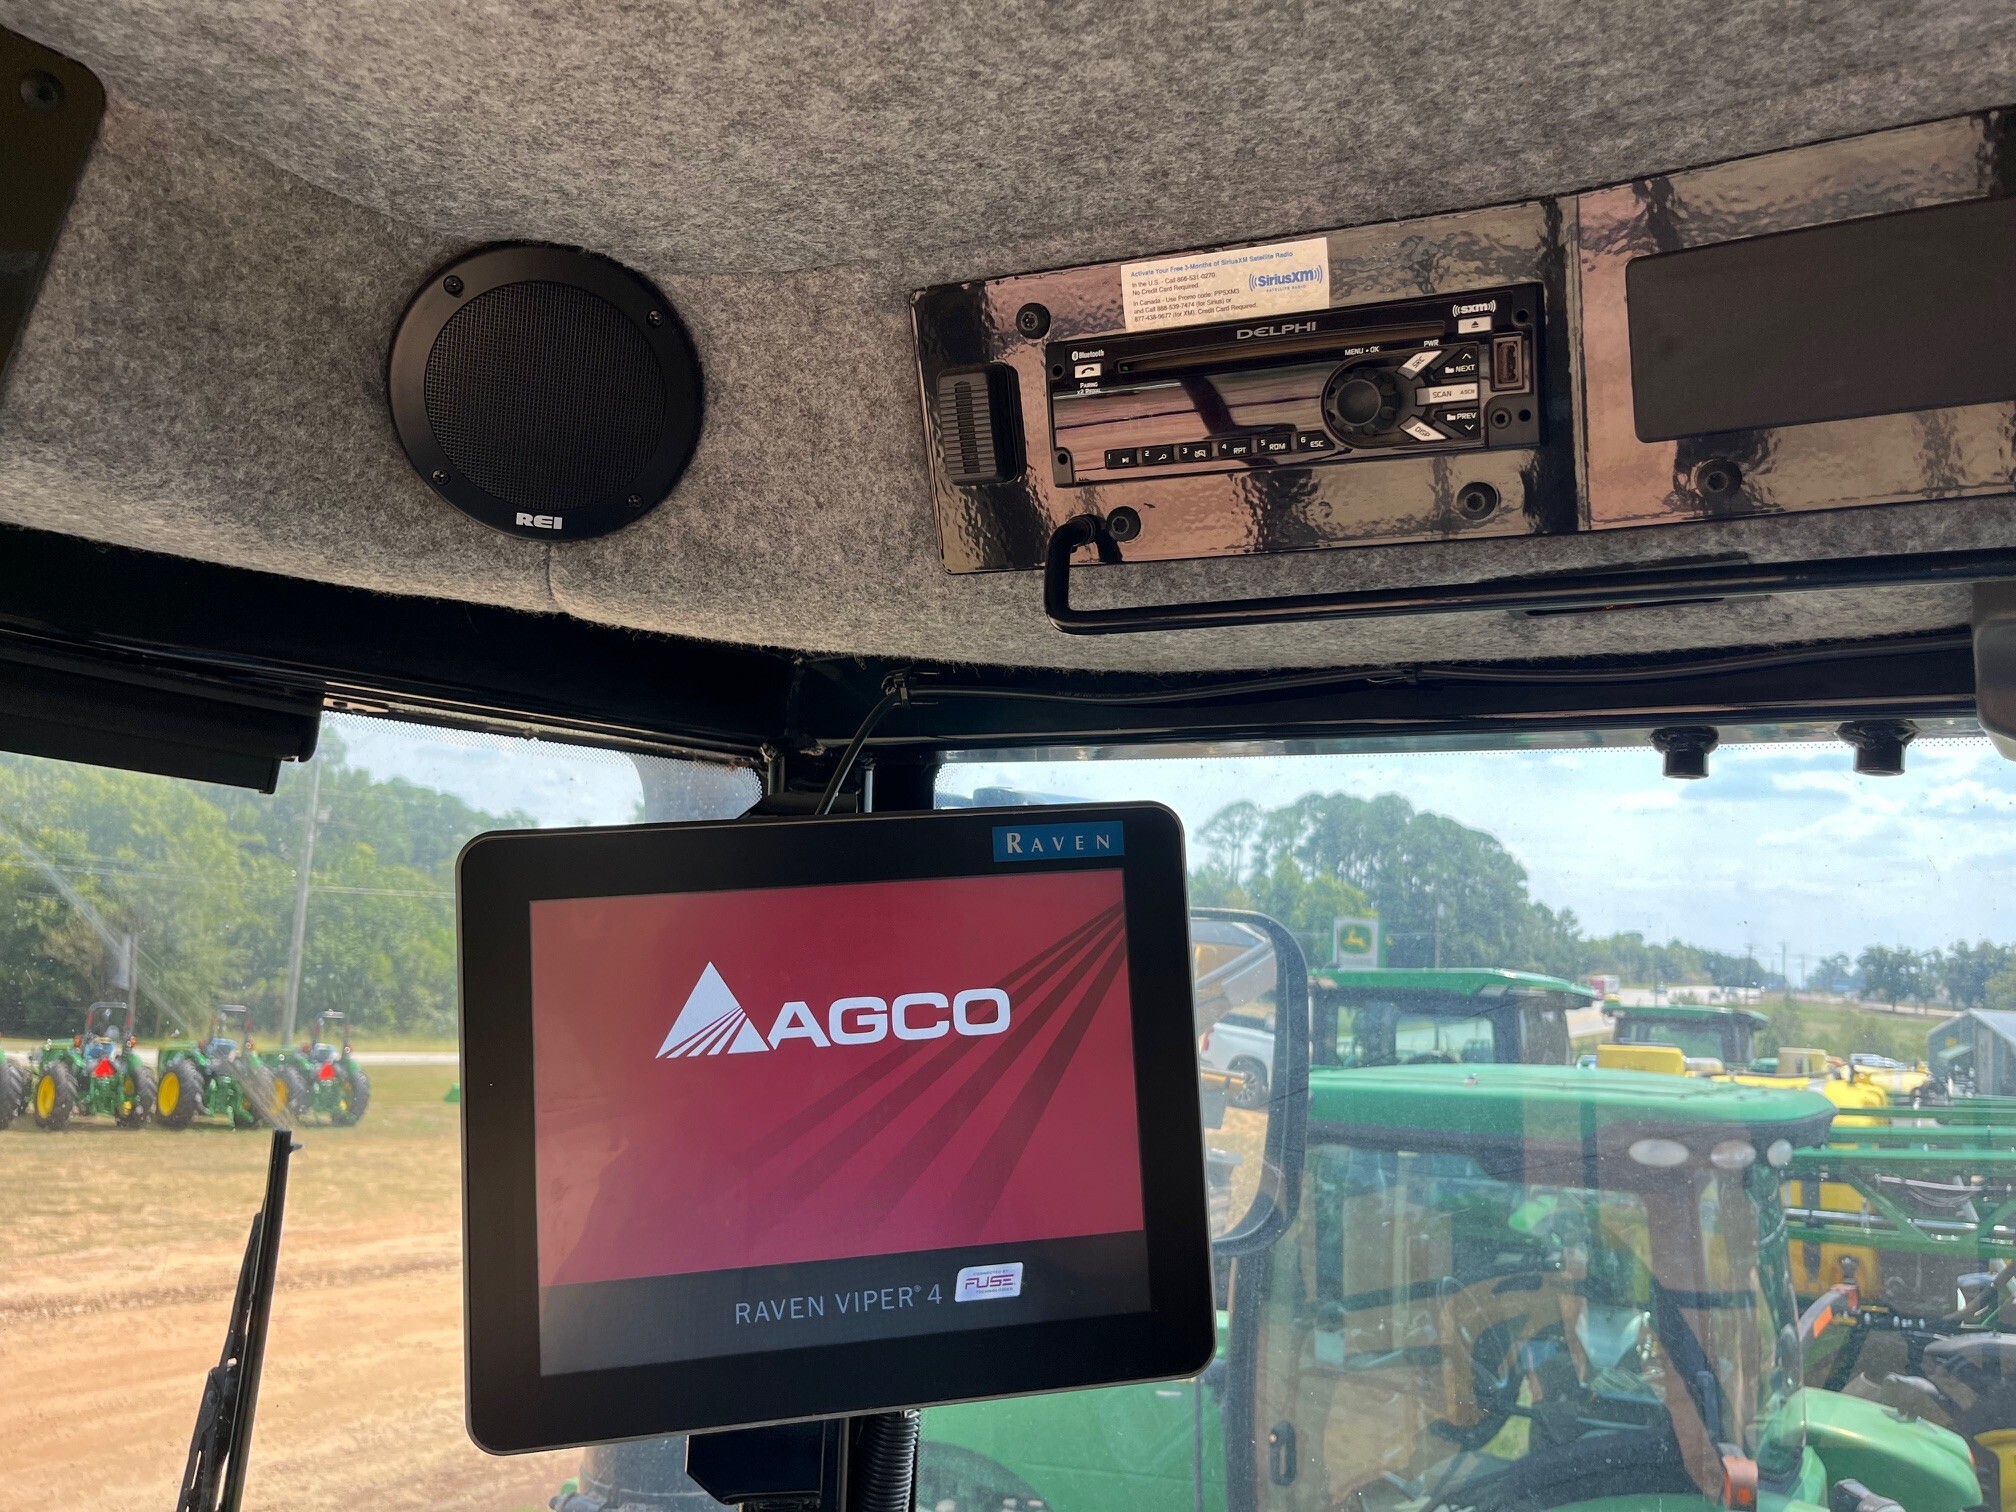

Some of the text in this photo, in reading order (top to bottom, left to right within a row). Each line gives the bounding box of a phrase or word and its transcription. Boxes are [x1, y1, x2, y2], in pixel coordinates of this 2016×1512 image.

[1185, 262, 1212, 270] 3-Months
[1221, 257, 1247, 266] SiriusXM
[1249, 253, 1274, 261] Satellite
[1140, 298, 1161, 306] Canada
[1236, 321, 1317, 340] DELPHI
[1424, 339, 1439, 348] PWR
[1079, 349, 1105, 359] Bluetooth
[1344, 348, 1364, 356] MENU
[1455, 364, 1476, 373] NEXT
[1432, 390, 1452, 399] SCAN
[1456, 412, 1477, 420] PREV
[1414, 426, 1431, 438] DISP
[1310, 440, 1324, 448] ESC
[1233, 447, 1247, 455] RPT
[516, 512, 563, 530] REI
[1006, 832, 1110, 854] RAVEN
[767, 988, 1012, 1051] AGCO
[965, 1274, 1015, 1290] FUSE
[735, 1294, 825, 1325] RAVEN
[927, 1283, 943, 1306] 4
